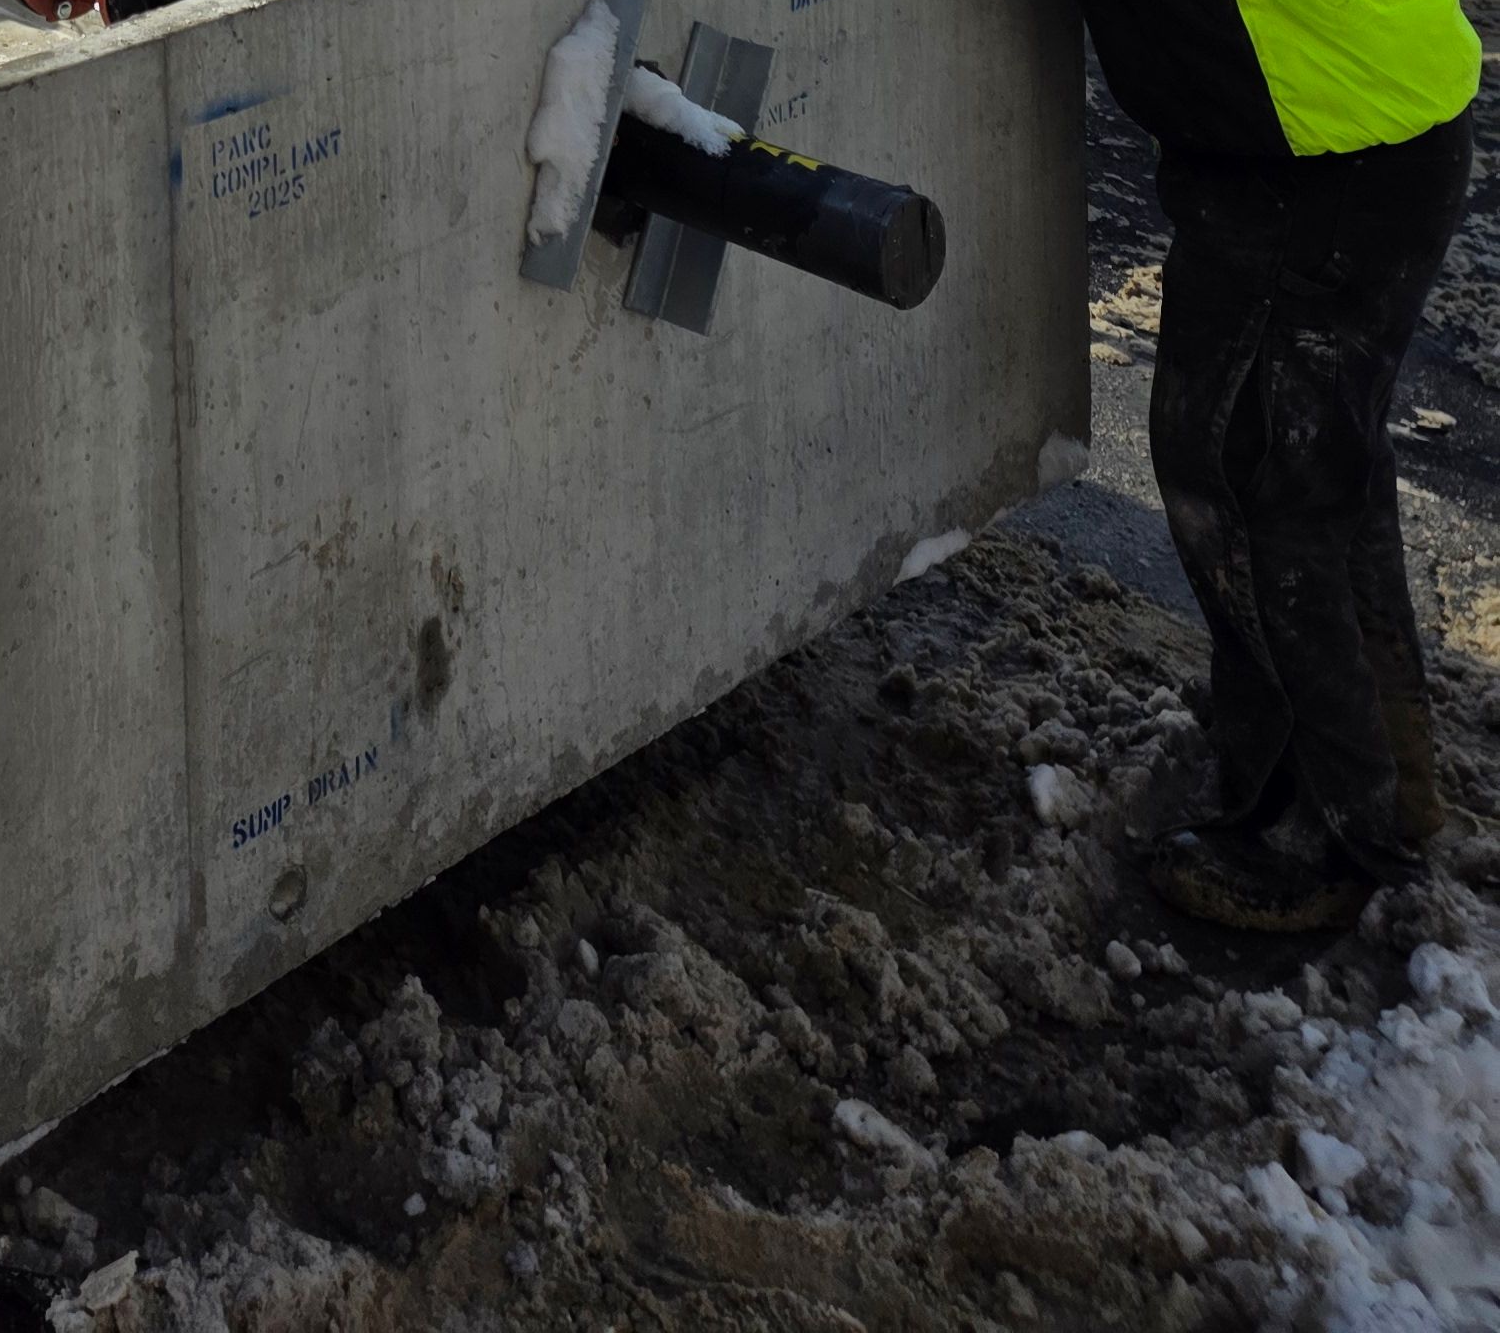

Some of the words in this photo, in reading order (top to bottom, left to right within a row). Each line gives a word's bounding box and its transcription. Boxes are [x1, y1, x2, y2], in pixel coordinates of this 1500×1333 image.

[212, 128, 342, 200] COMPLIANT
[248, 174, 306, 220] 2025
[232, 793, 293, 850] SUMP
[307, 745, 379, 807] DRAIN
